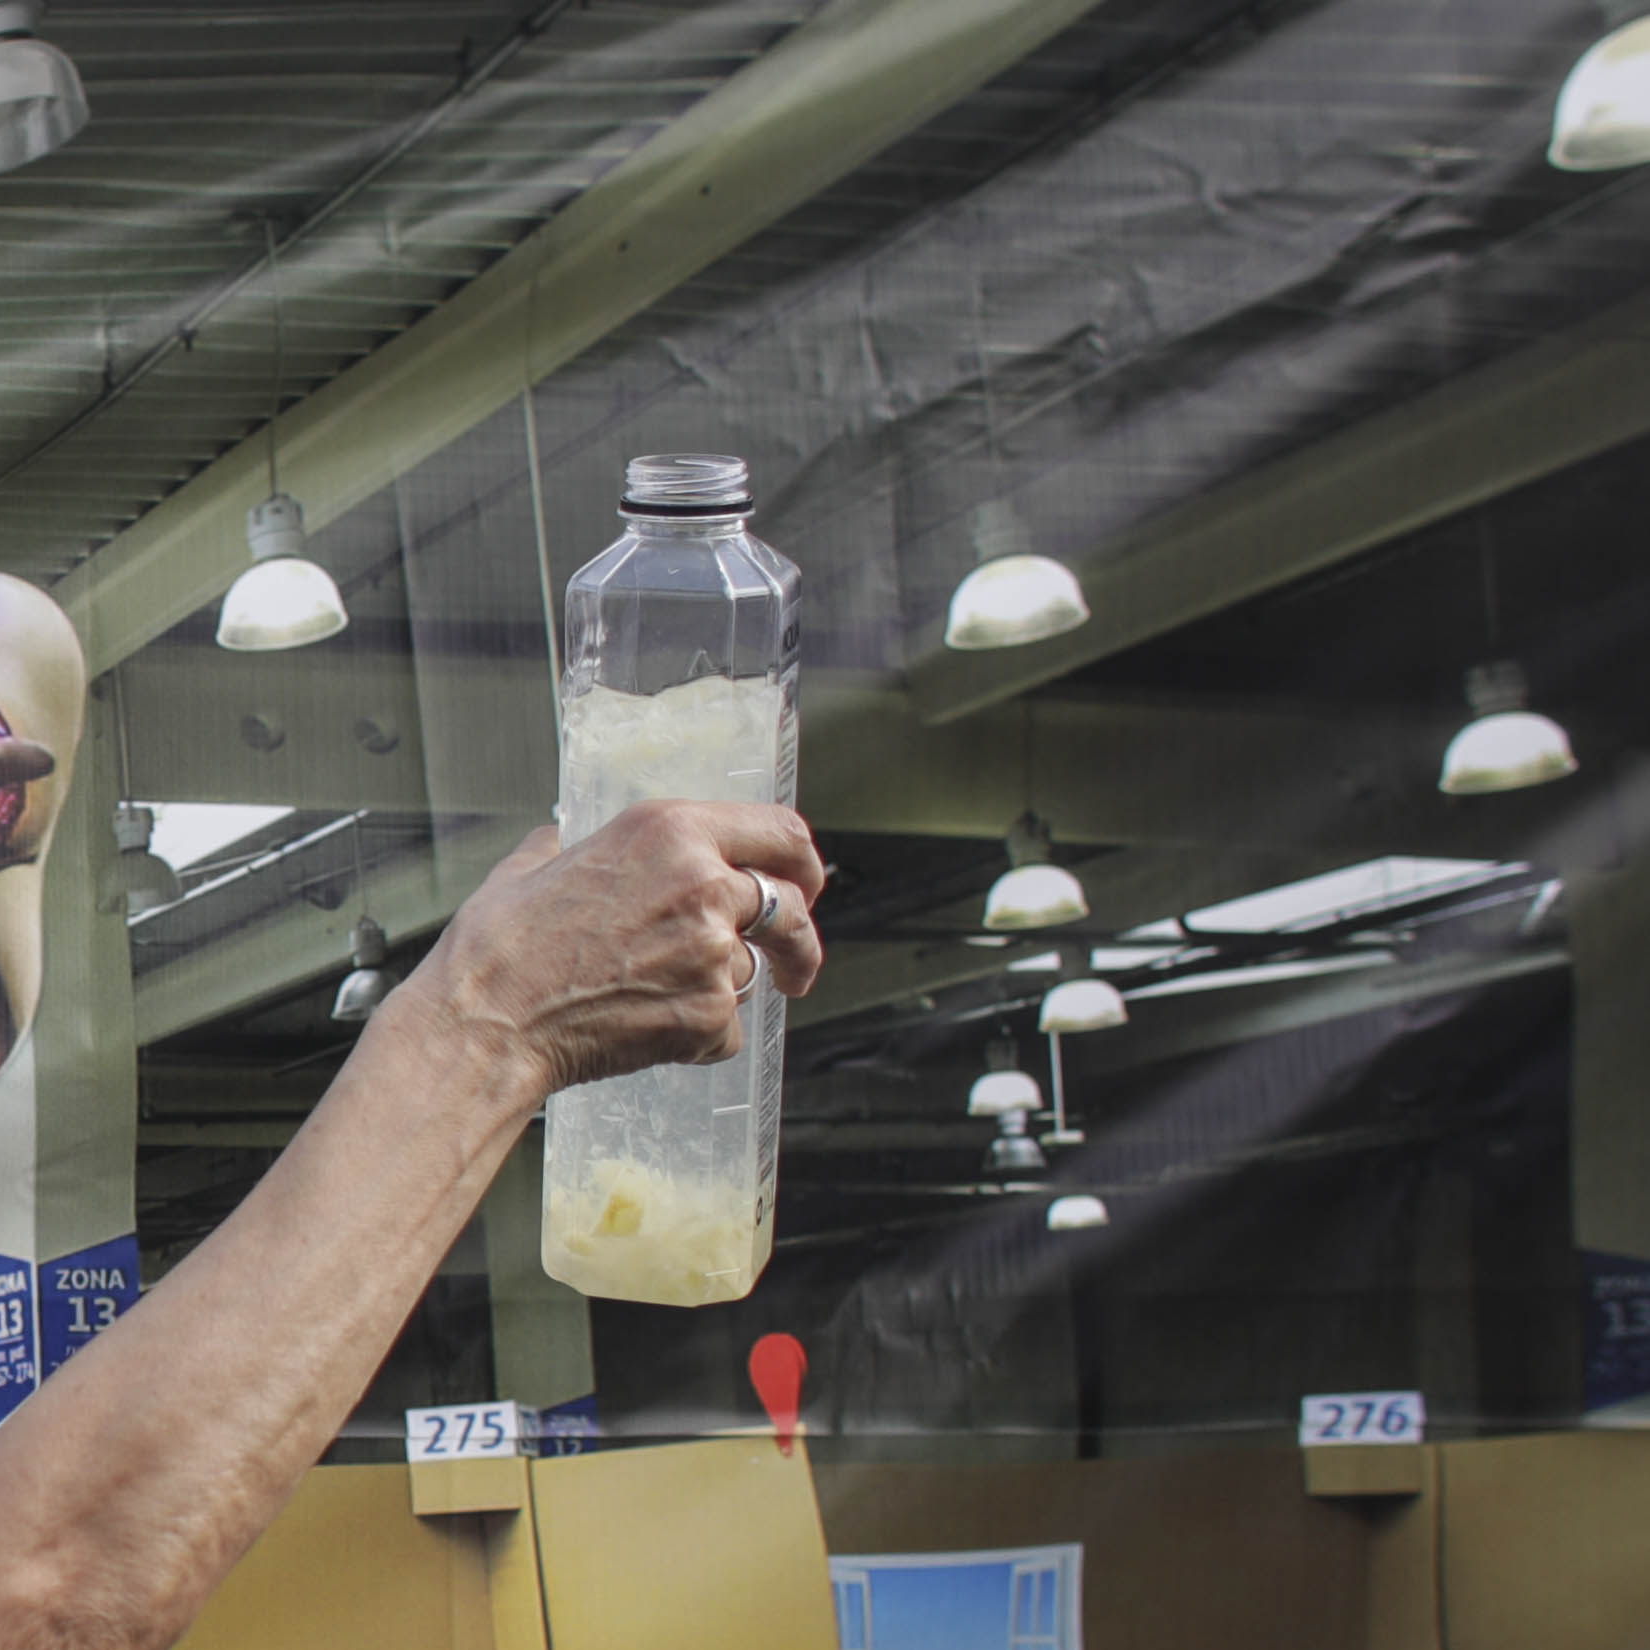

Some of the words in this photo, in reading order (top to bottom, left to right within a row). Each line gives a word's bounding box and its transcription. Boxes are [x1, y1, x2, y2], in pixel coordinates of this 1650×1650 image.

[55, 1268, 125, 1290] ZONA
[67, 1297, 117, 1332] 13
[422, 1410, 506, 1454] 275
[1317, 1400, 1410, 1438] 276
